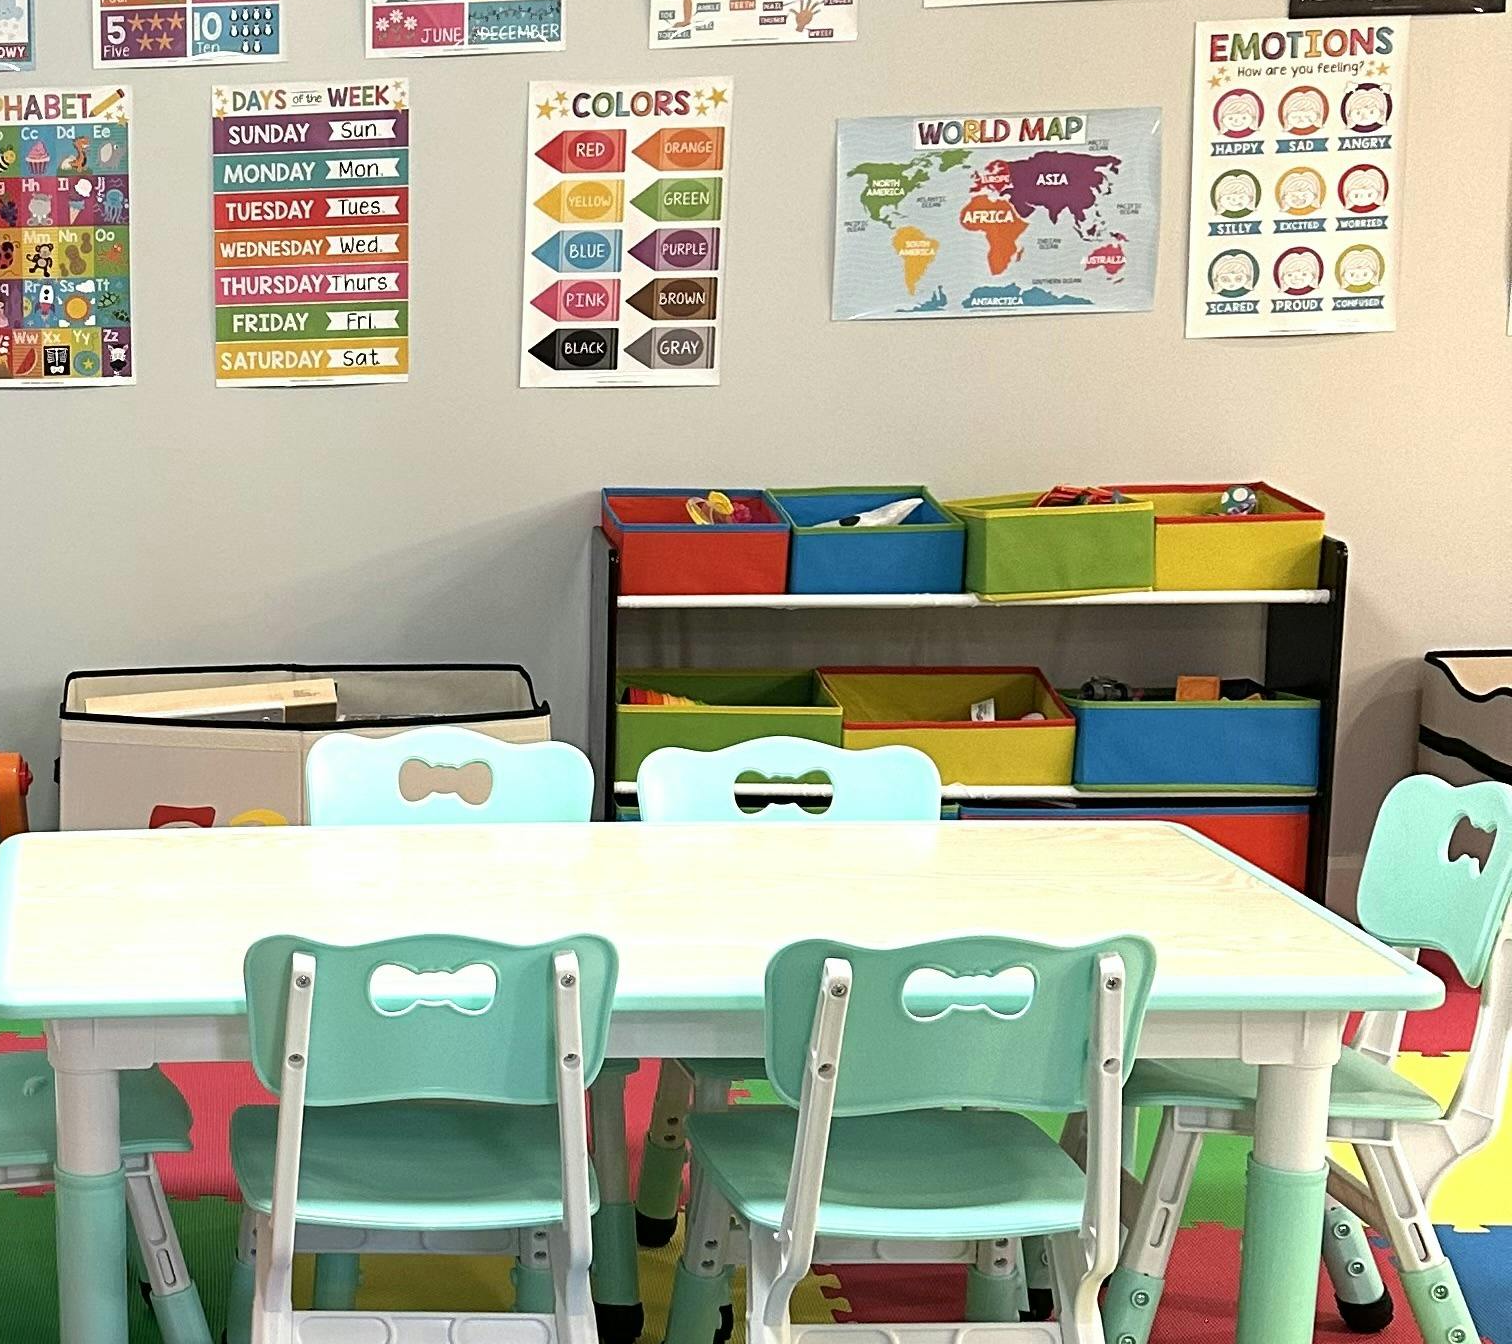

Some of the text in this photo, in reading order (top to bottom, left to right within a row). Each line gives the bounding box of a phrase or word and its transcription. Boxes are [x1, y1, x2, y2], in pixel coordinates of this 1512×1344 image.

[193, 12, 221, 41] 10
[1210, 27, 1394, 62] EMOTIONS
[1238, 61, 1365, 78] How are you feeling?
[233, 85, 390, 113] DAYS of the WEEK
[572, 90, 690, 120] COLORS
[57, 126, 75, 139] Dd
[228, 123, 310, 144] SUNDAY
[918, 117, 1083, 145] WORLD MAP
[575, 143, 605, 159] RED
[664, 139, 713, 155] ORANGE
[1216, 143, 1258, 155] HAPPY
[1289, 141, 1313, 152] SAD
[1342, 138, 1386, 150] ANGRY
[224, 161, 314, 183] MONDAY
[1036, 173, 1068, 186] ASIA
[568, 194, 611, 208] YELLOW
[664, 191, 709, 207] GREEN
[226, 200, 314, 221] TUESDAY
[962, 211, 1014, 223] AFRICA
[1217, 223, 1251, 234] SILLY
[220, 239, 324, 258] WEDNESDAY
[569, 243, 605, 259] BLUE
[221, 274, 325, 295] THURSDAY
[971, 297, 1024, 306] ANTARCTICA
[1275, 300, 1318, 311] PROUD
[233, 313, 309, 333] FRIDAY
[104, 329, 118, 342] Zz
[564, 339, 605, 356] BLACK
[221, 349, 324, 371] SATURDAY
